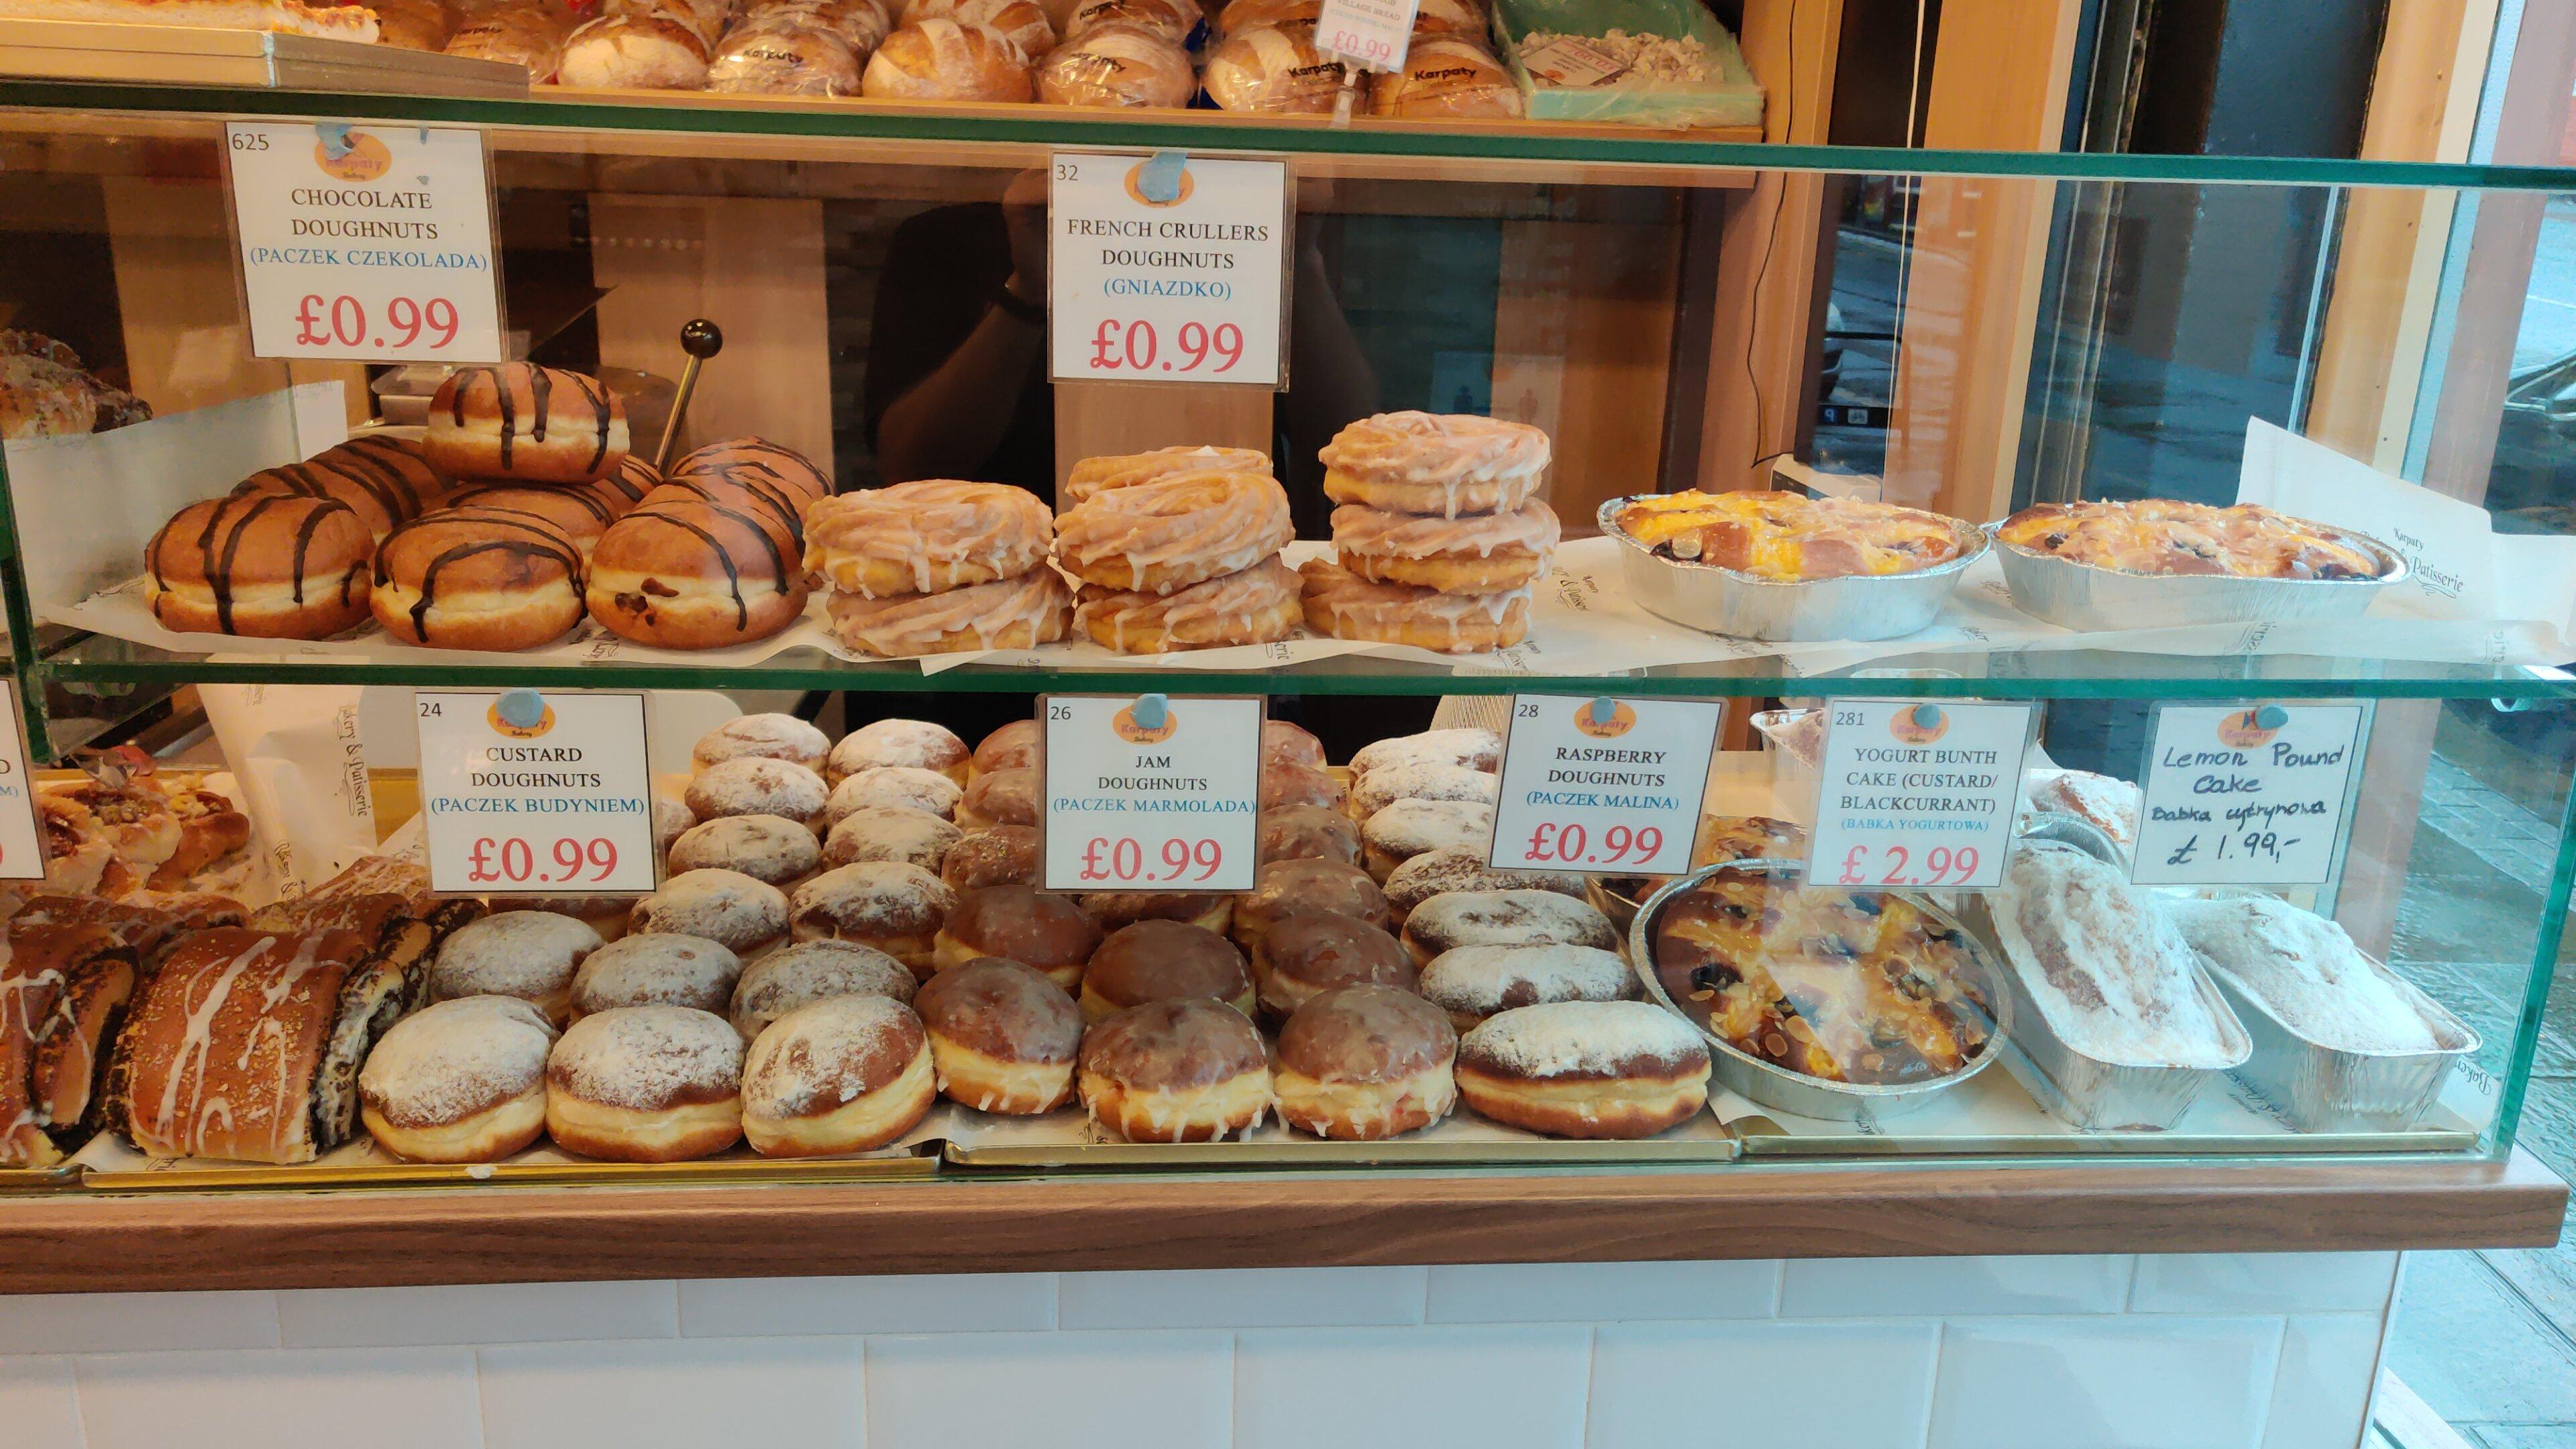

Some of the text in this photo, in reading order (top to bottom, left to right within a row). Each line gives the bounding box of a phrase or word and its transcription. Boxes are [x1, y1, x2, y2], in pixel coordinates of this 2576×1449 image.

[1373, 8, 1400, 21] BREAD
[1332, 30, 1391, 62] £0.99
[1289, 61, 1346, 78] Karpaty
[1414, 67, 1477, 81] Karpaty
[232, 133, 270, 151] 625
[1056, 164, 1079, 182] 32
[291, 189, 433, 209] CHOCOLATE
[292, 219, 439, 240] DOUGHNUTS
[1067, 219, 1269, 241] FRENCH CRULLERS
[250, 247, 488, 272] (PACZEK CZEKOLADA)
[1102, 249, 1235, 269] DOUGHNUTS
[1104, 278, 1232, 302] (GNIAZDKO)
[295, 294, 459, 349] £0.99
[1090, 319, 1243, 373] £0.99
[2394, 527, 2424, 552] Karpaty
[2410, 555, 2464, 593] Patisserie
[419, 702, 443, 717] 24
[1050, 706, 1071, 720] 26
[1518, 704, 1539, 718] 28
[1835, 712, 1864, 727] 281
[486, 747, 582, 762] CUSTARD
[1136, 756, 1171, 768] JAM
[1555, 747, 1667, 764] RASPBERRY
[1854, 748, 1998, 764] YOGURT BUNTH
[2163, 742, 2345, 768] Lemon Pound
[472, 773, 601, 788] DOUGHNUTS
[1098, 777, 1208, 790] DOUGHNUTS
[1548, 769, 1665, 787] DOUGHNUTS
[1846, 772, 1998, 790] CAKE (CUSTARD/
[2193, 774, 2263, 794] Cake
[431, 797, 645, 816] (PACZEK BUDYNIEM)
[1054, 798, 1255, 815] (PACZEK MARMOLADA)
[1526, 791, 1679, 811] (PACZEK MALINA)
[1840, 796, 1996, 814] BLACKCURRANT)
[2151, 806, 2212, 822] Babka
[1841, 818, 1989, 833] (BABKA YOGURTOWA)
[1524, 822, 1663, 865] £0.99
[468, 837, 618, 882] £0.99
[1080, 837, 1222, 881] £0.99
[1880, 846, 1979, 885] 2.99
[2456, 1060, 2491, 1096] Baker
